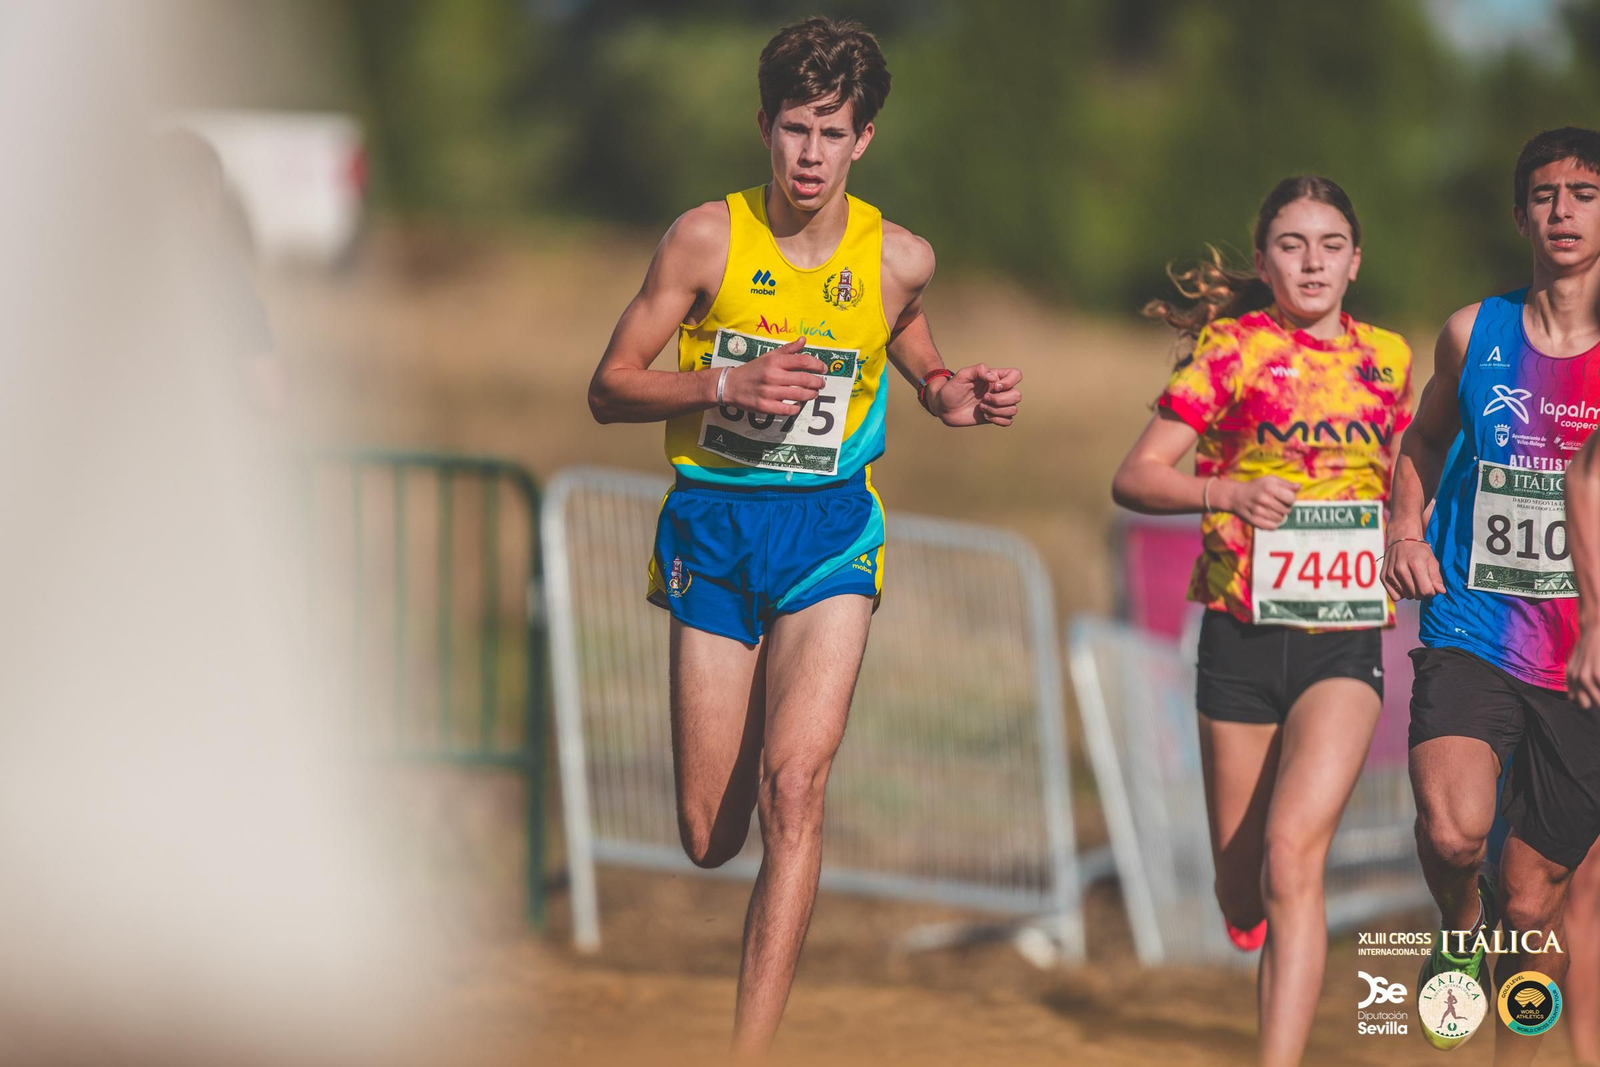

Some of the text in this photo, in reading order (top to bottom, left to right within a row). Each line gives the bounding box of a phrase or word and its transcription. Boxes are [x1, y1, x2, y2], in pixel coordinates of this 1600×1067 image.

[750, 287, 776, 296] mobel
[755, 314, 837, 341] Andalucía
[1355, 365, 1394, 384] VAS
[1540, 397, 1600, 423] lapalm
[1269, 550, 1377, 589] 7440
